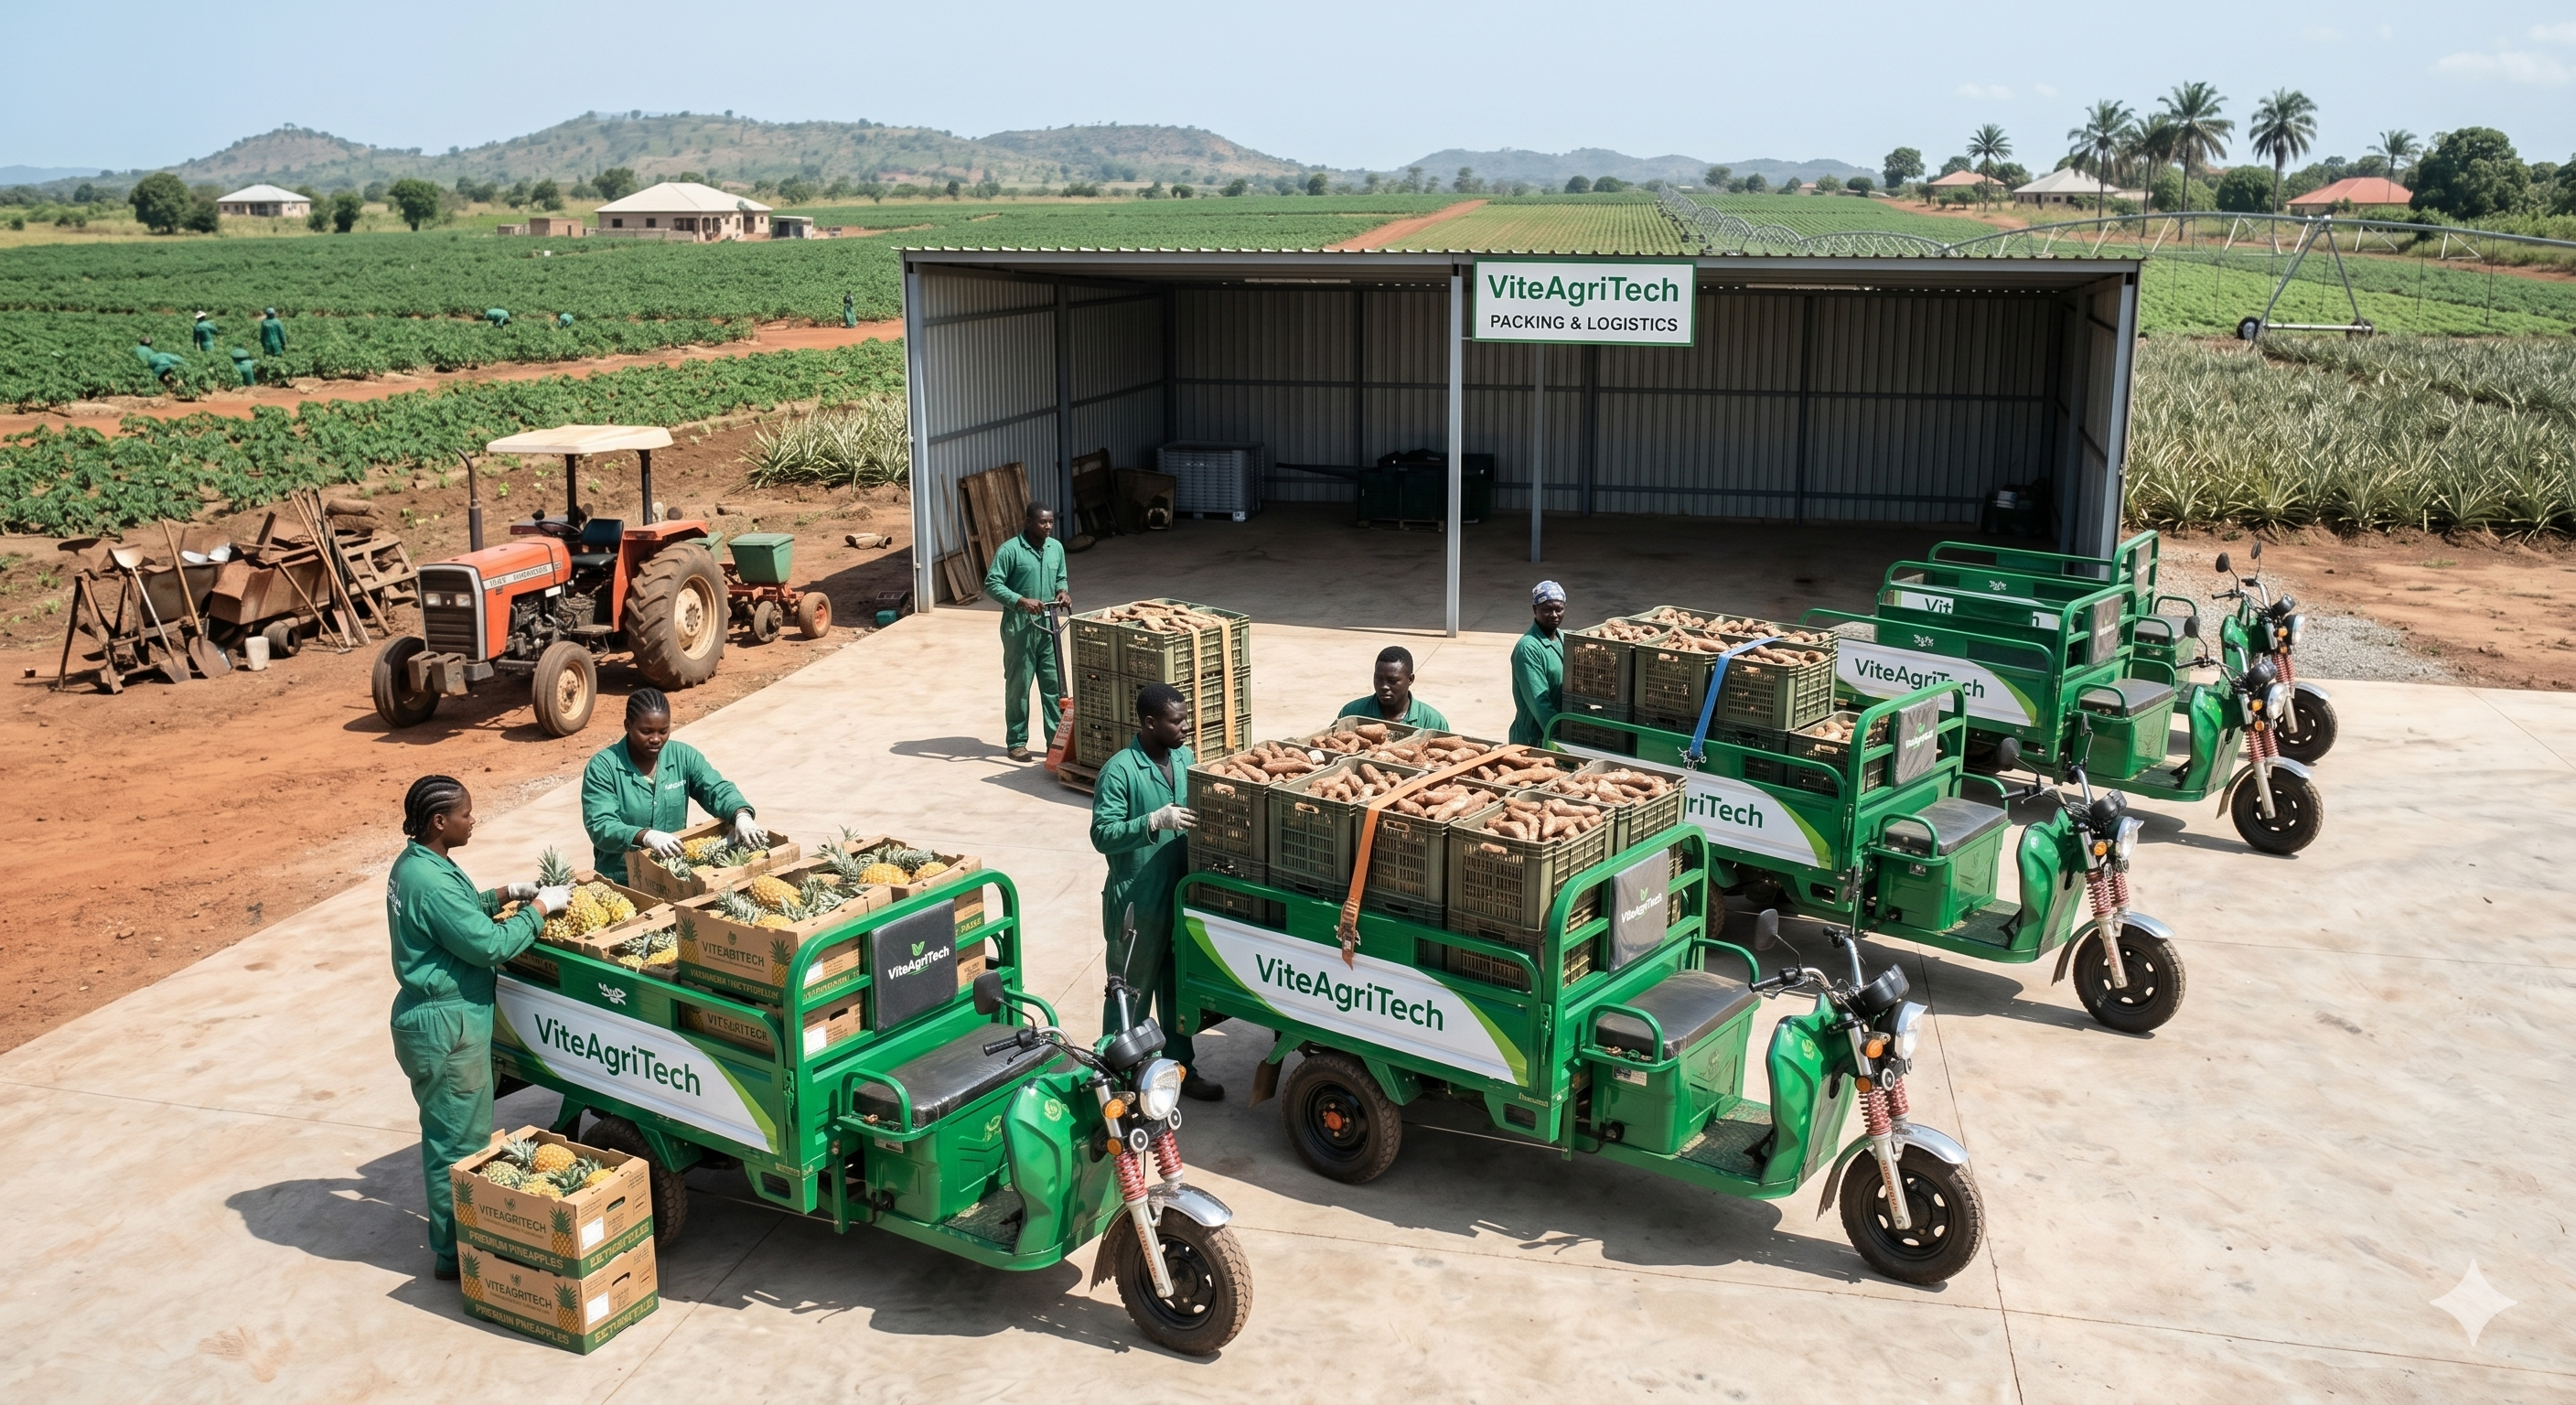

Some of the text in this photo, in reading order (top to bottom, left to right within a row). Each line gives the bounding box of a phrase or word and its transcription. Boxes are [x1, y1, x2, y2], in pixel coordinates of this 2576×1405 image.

[1487, 274, 1679, 307] ViteAgriTech
[1490, 315, 1678, 332] PACKING & LOGISTICS
[1854, 658, 1985, 699] ViteAgriTch
[887, 945, 950, 980] ViteAgriTech
[1255, 953, 1444, 1032] ViteAgriTech
[534, 1013, 701, 1097] ViteAgriTech
[478, 1203, 547, 1234] VITEAGRITECH
[485, 1278, 553, 1310] VITEAGRITECH
